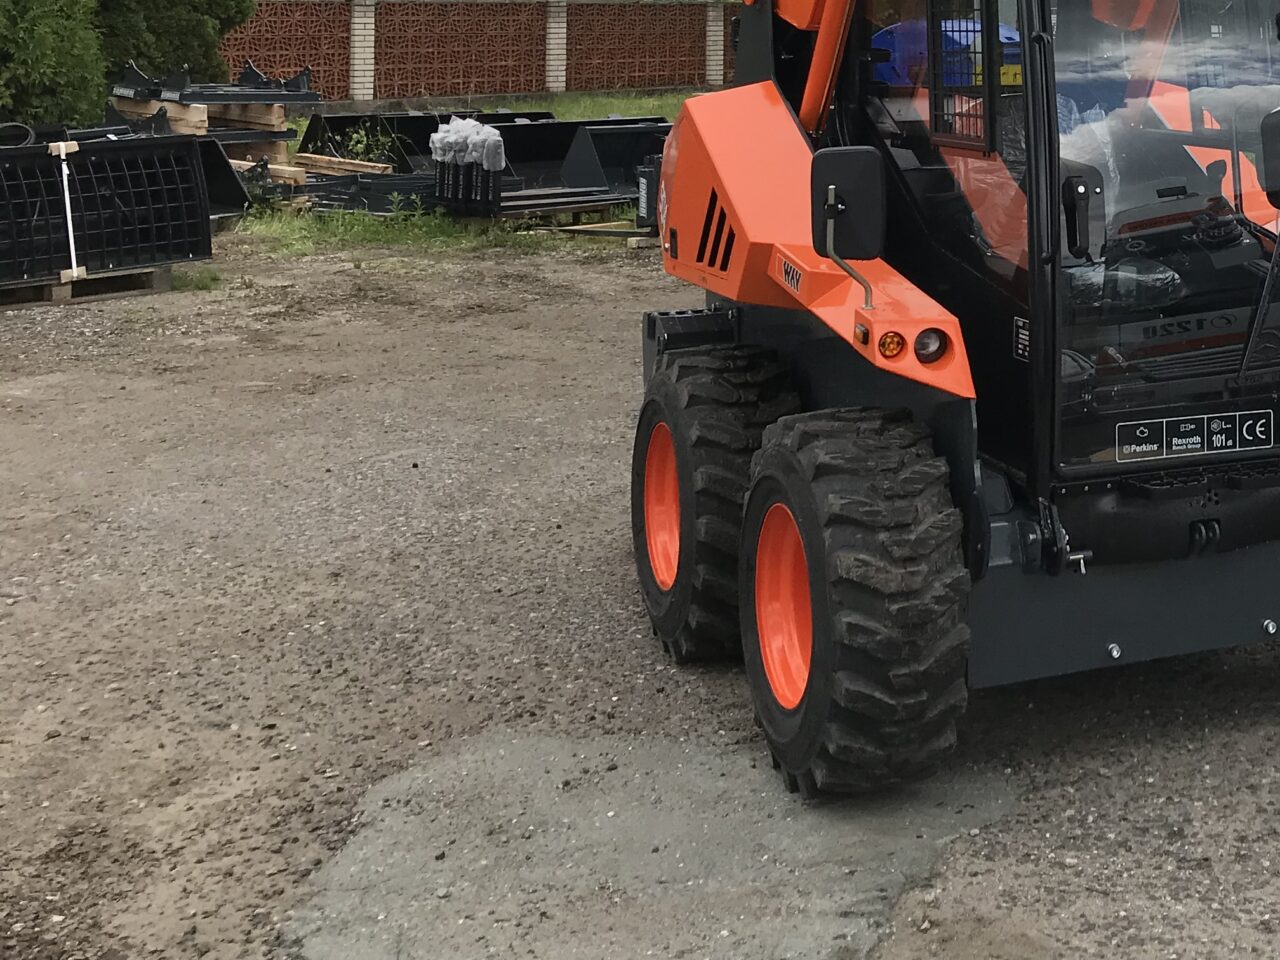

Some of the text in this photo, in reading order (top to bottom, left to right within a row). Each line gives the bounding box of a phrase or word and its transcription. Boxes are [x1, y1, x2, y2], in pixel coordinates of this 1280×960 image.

[782, 259, 802, 293] WAY
[1172, 435, 1202, 445] Rexroth
[1211, 433, 1226, 448] 101
[1130, 443, 1158, 453] Perkins
